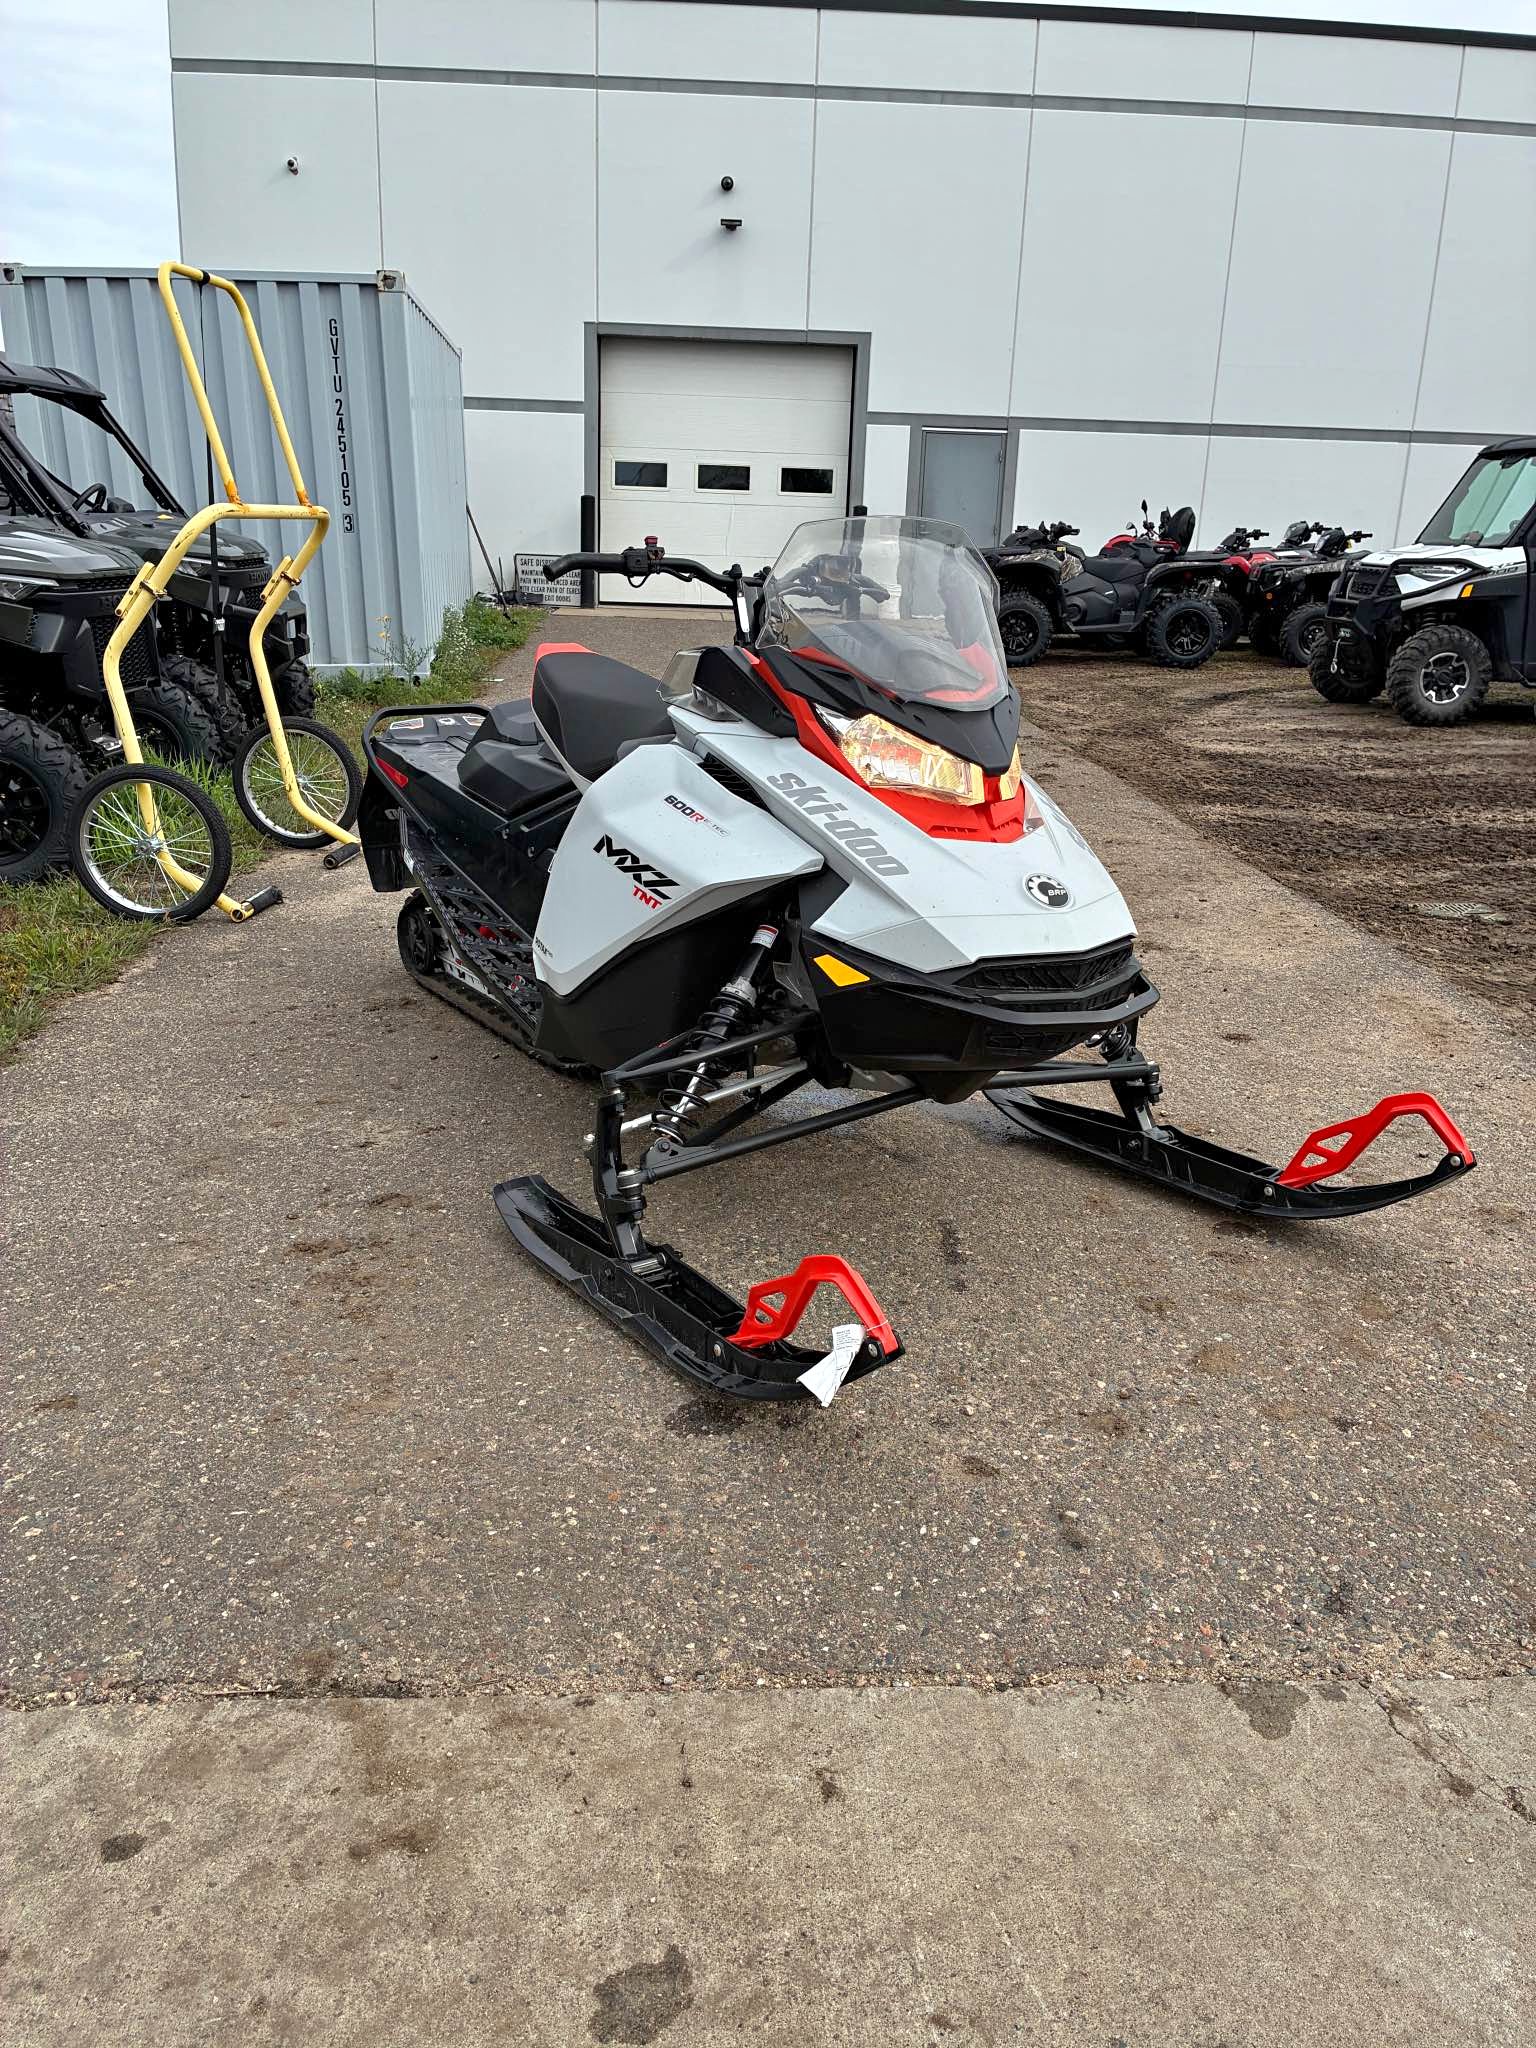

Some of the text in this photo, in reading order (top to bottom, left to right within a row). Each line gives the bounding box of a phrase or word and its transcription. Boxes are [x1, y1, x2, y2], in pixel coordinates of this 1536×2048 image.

[328, 318, 354, 533] GVTU 245105 3
[520, 558, 534, 566] SAFE
[663, 794, 705, 823] 600R
[632, 884, 663, 910] TNT
[1047, 889, 1067, 897] BRP
